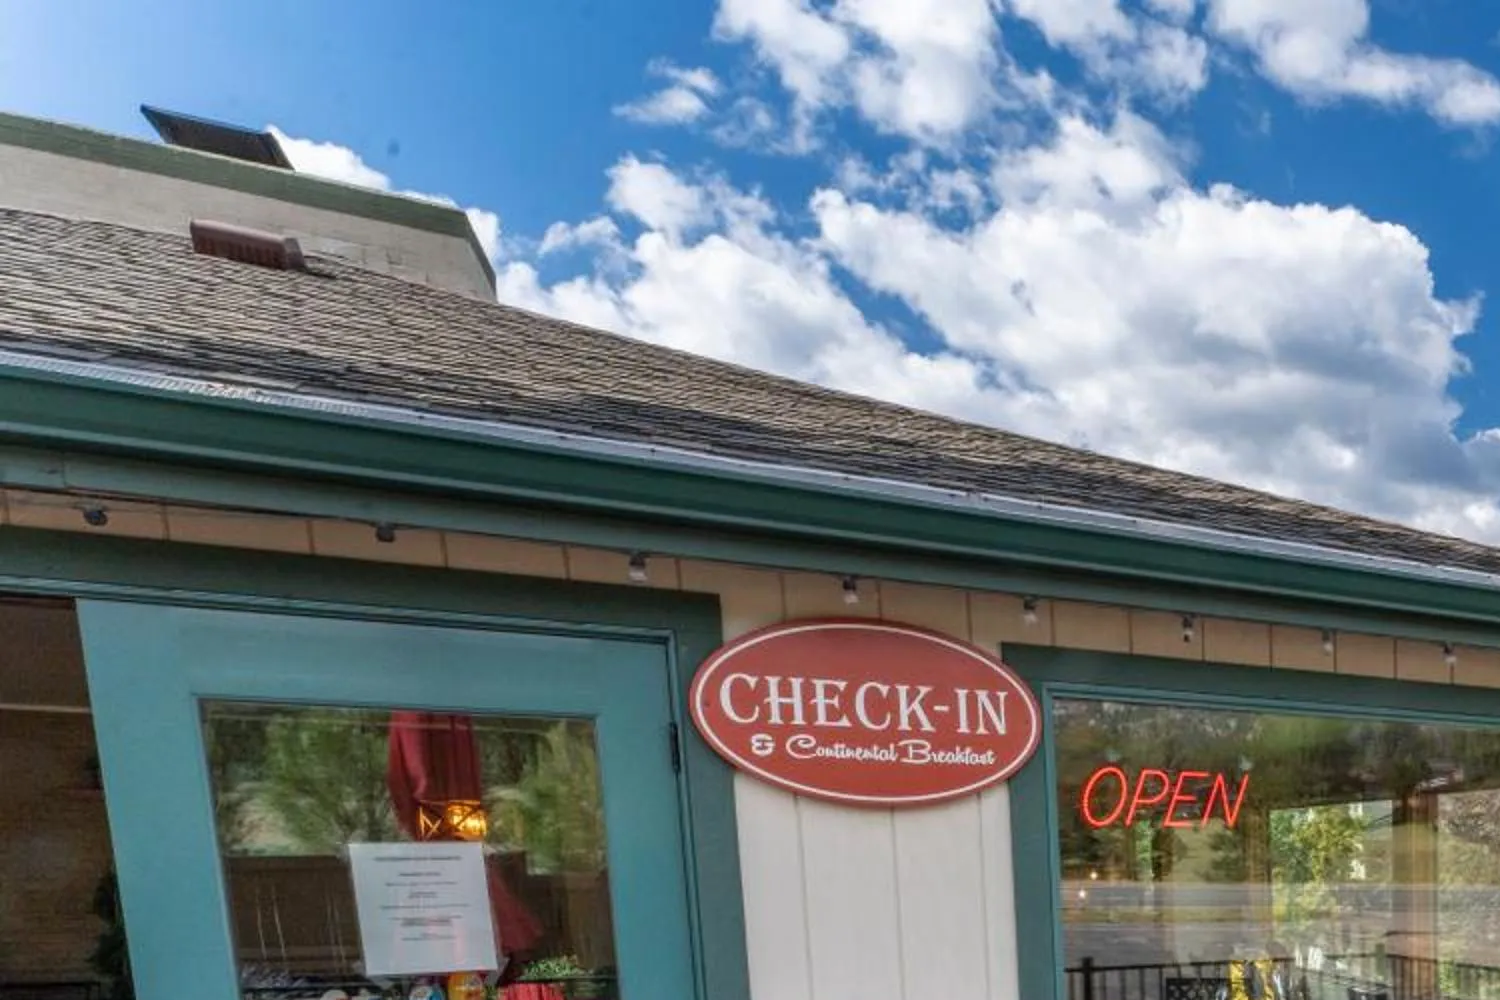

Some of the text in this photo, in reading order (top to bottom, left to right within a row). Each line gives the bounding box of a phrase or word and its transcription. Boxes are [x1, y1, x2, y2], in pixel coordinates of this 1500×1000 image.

[719, 673, 1009, 736] CHECK-IN
[750, 733, 996, 765] & Continental Breakfast
[1082, 766, 1249, 828] OPEN
